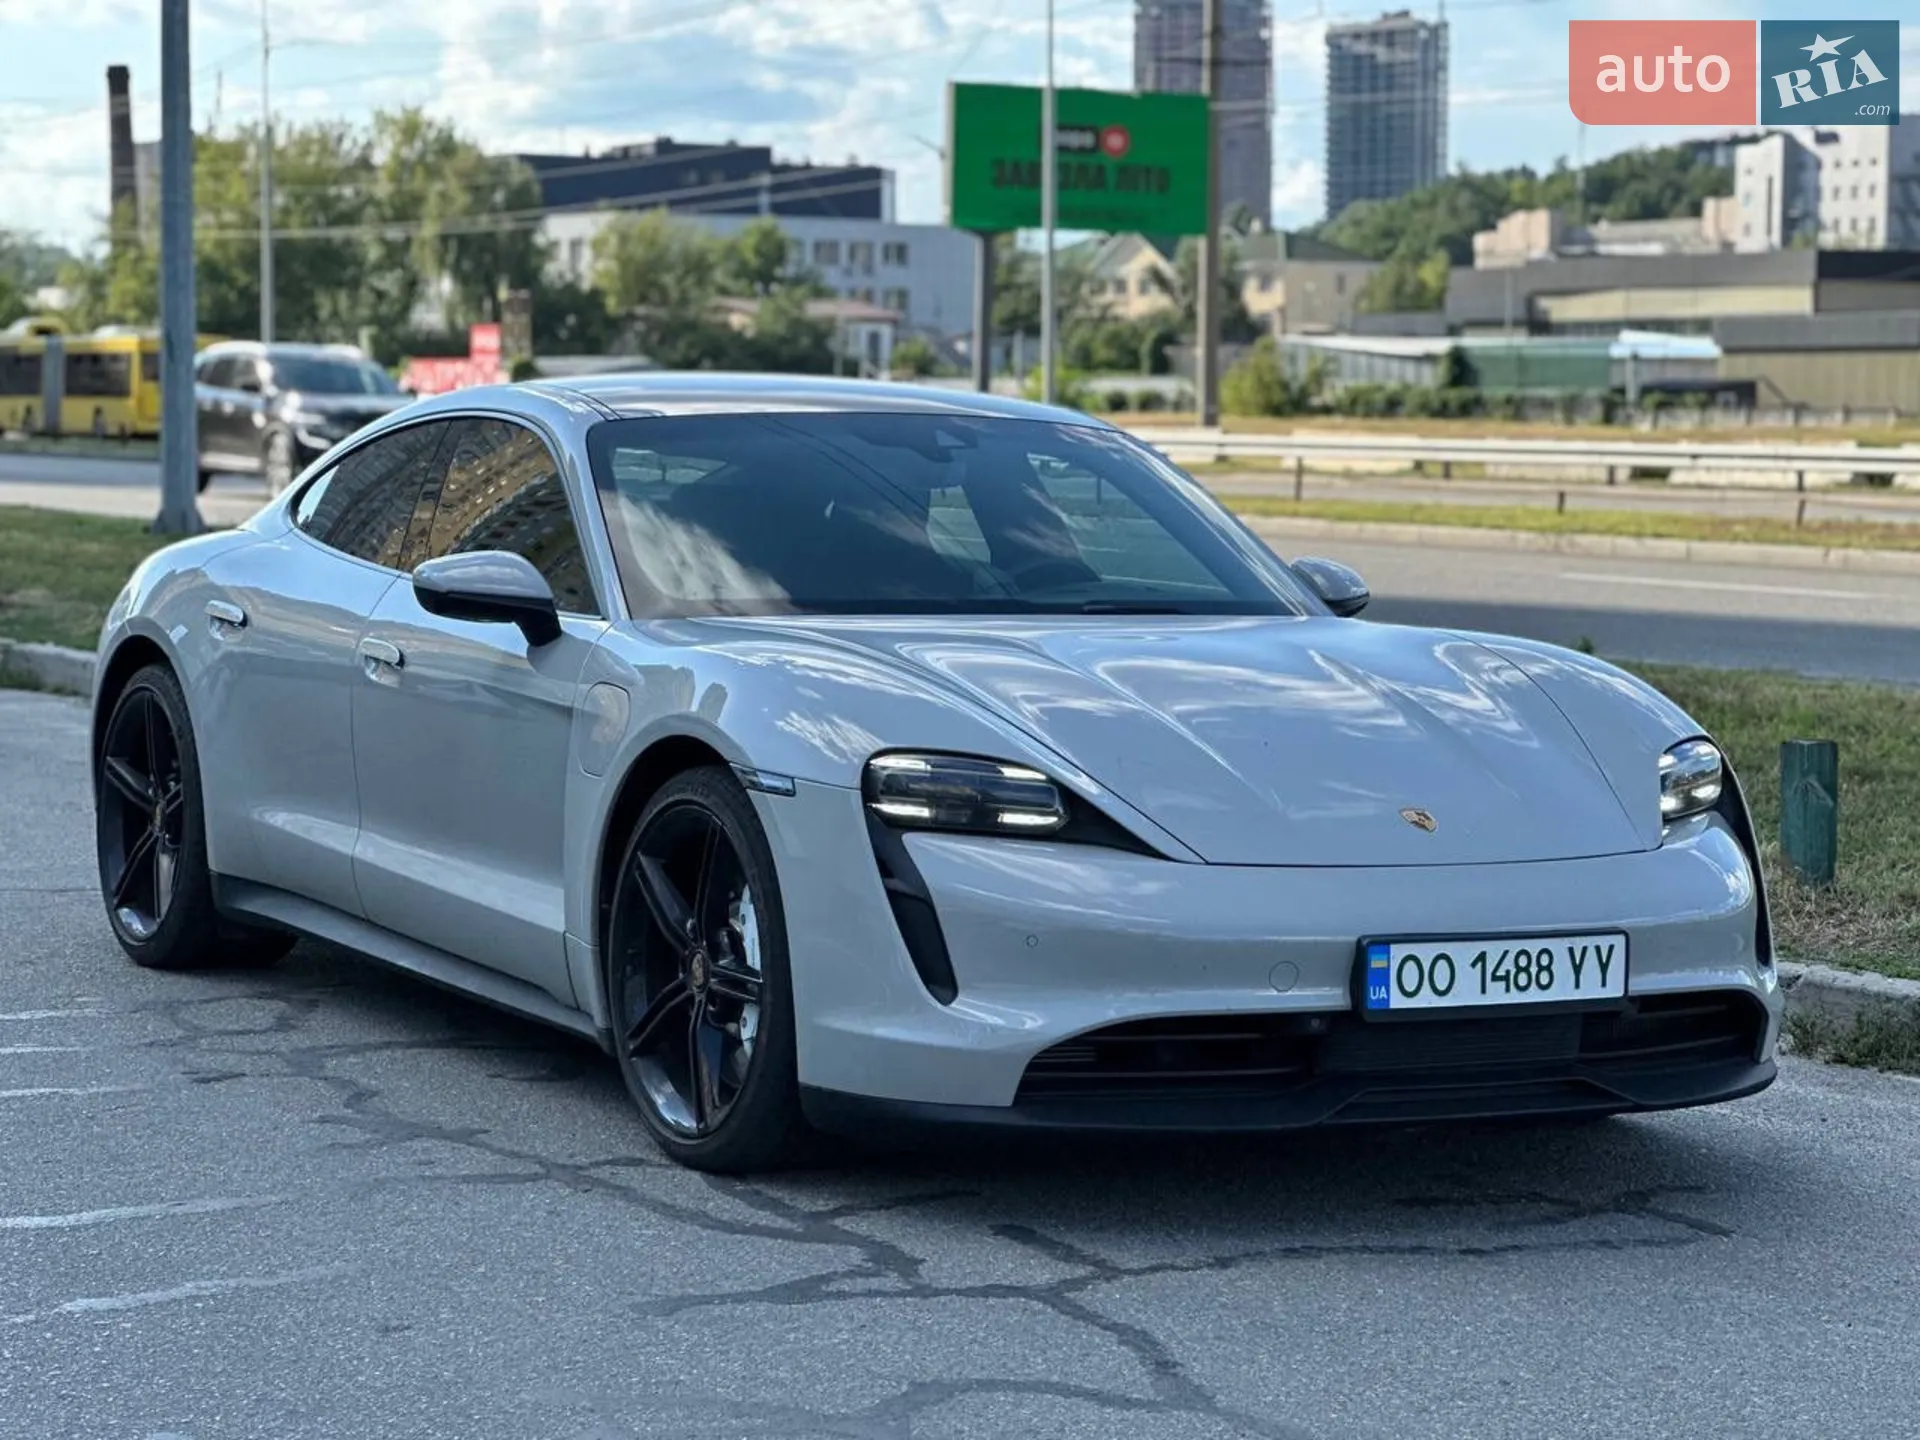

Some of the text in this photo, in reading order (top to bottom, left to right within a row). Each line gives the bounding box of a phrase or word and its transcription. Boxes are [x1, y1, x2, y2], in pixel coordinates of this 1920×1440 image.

[991, 159, 1107, 191] ЗАВЗЛА
[1396, 943, 1616, 999] OO 1488 YY
[1369, 985, 1389, 1000] UA
